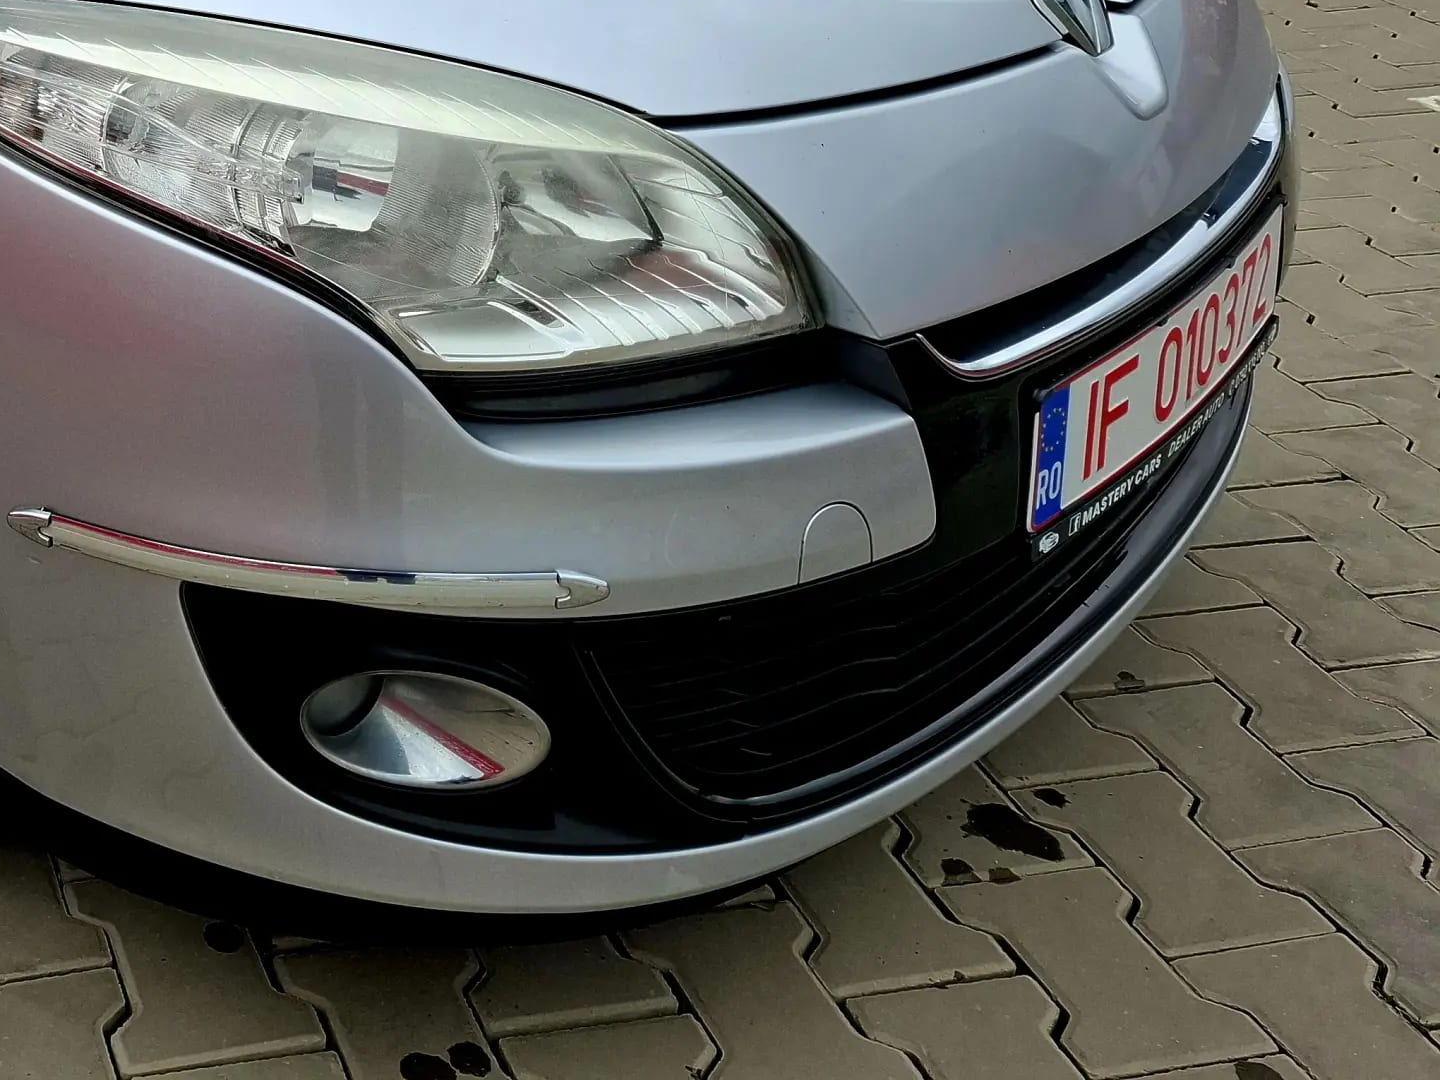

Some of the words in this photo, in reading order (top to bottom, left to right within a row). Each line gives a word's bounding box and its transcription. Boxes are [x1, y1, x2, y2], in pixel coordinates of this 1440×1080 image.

[1081, 353, 1141, 482] IF
[1155, 230, 1273, 423] 010372
[1035, 461, 1062, 510] RO
[1081, 475, 1135, 527] MASTERY
[1134, 453, 1163, 486] CARS
[1167, 414, 1204, 459] DEALER
